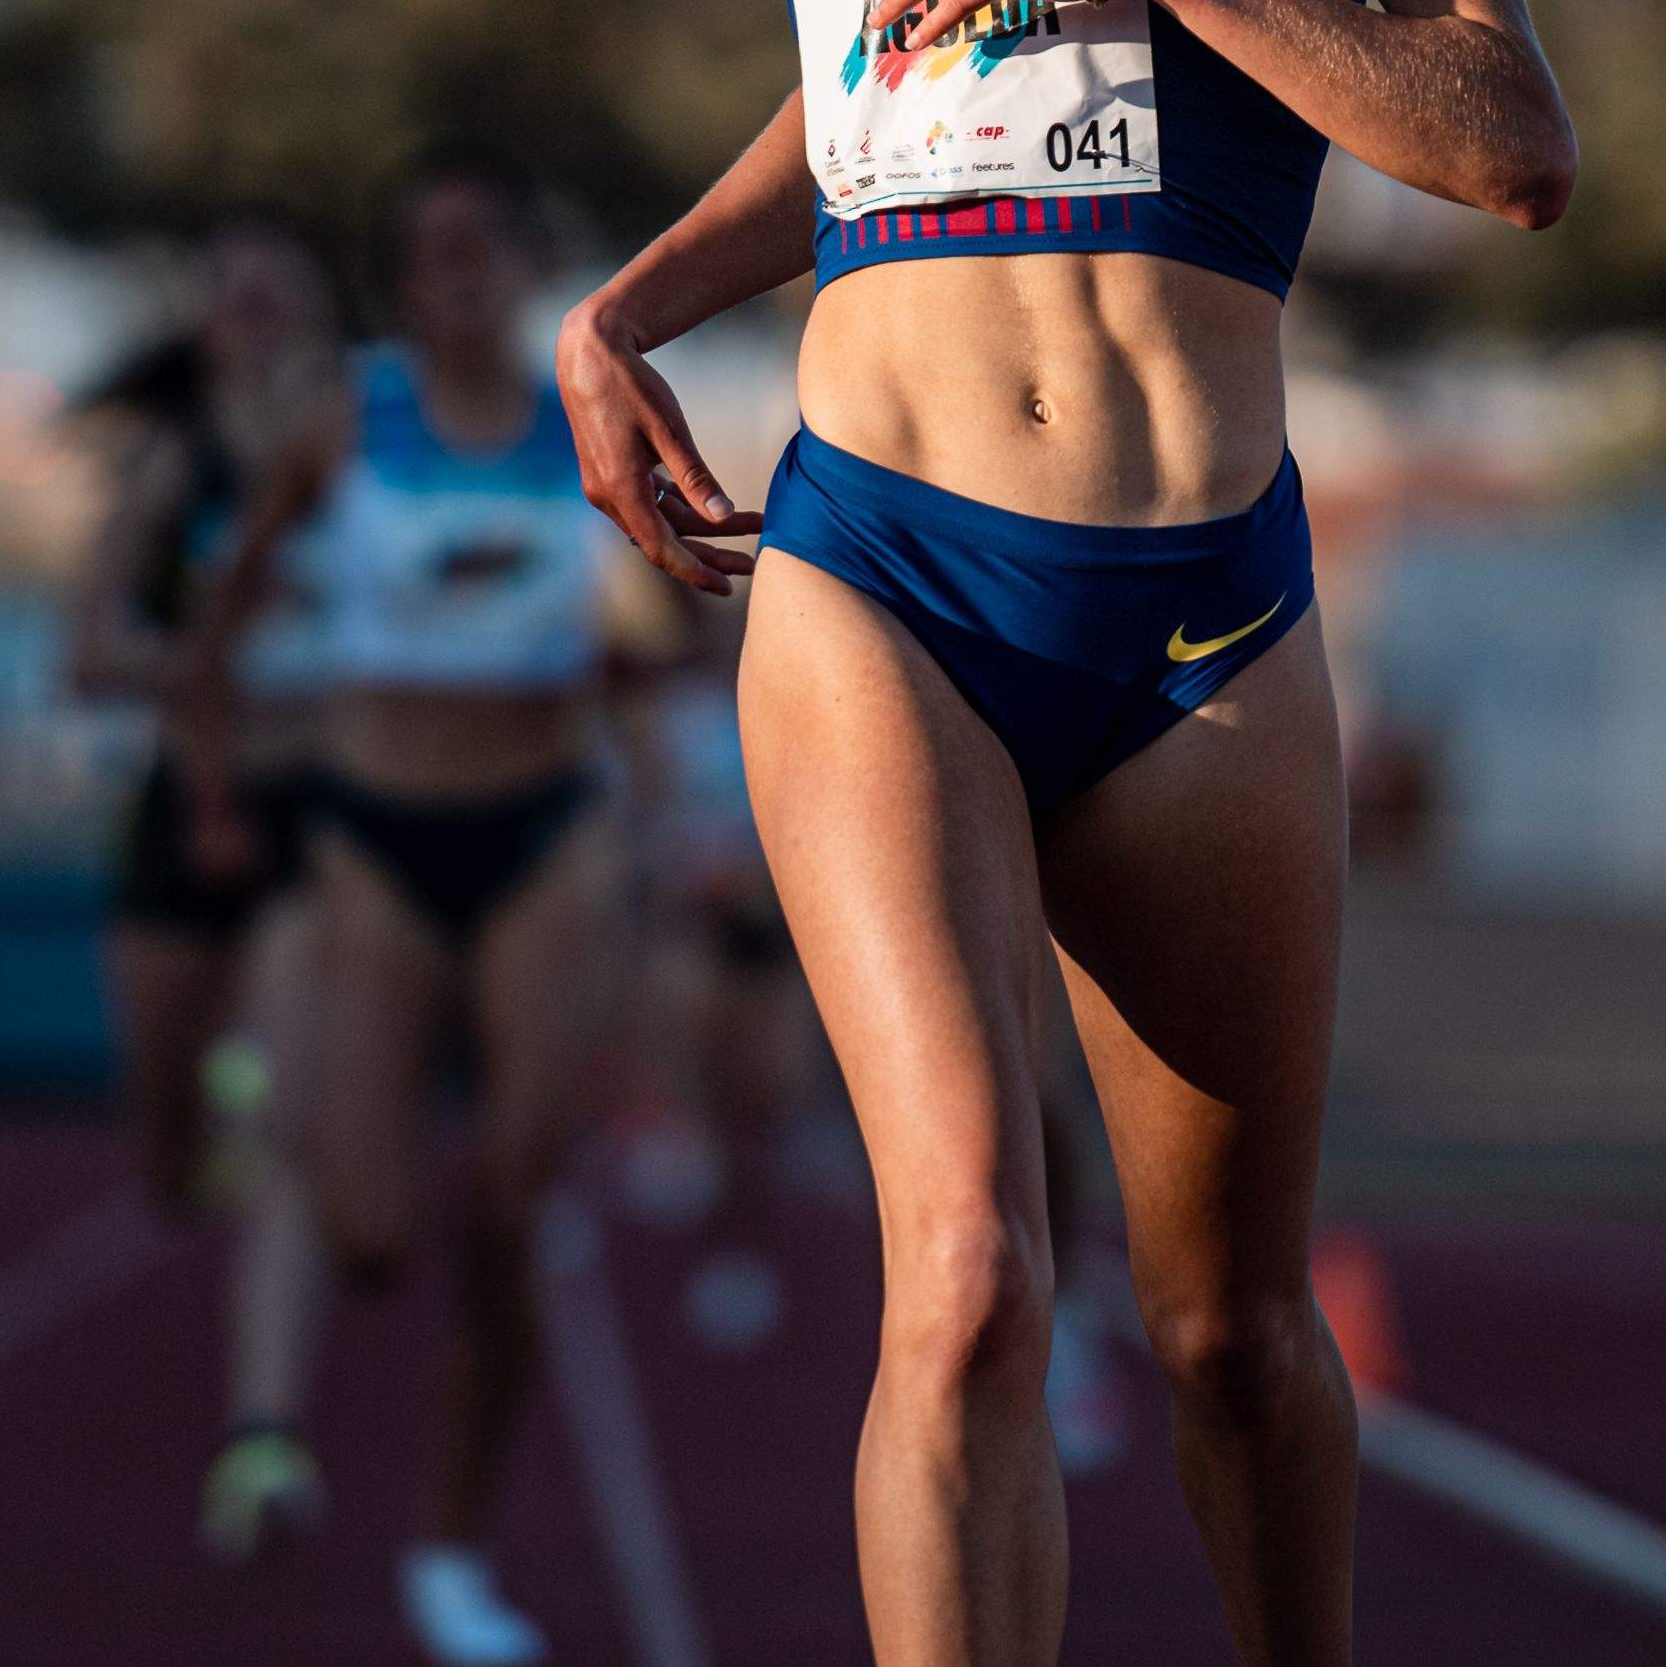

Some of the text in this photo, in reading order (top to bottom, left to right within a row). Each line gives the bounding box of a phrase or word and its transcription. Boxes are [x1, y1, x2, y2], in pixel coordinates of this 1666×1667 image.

[976, 126, 1005, 140] cap
[1046, 118, 1130, 172] 041
[972, 162, 1015, 172] feetures
